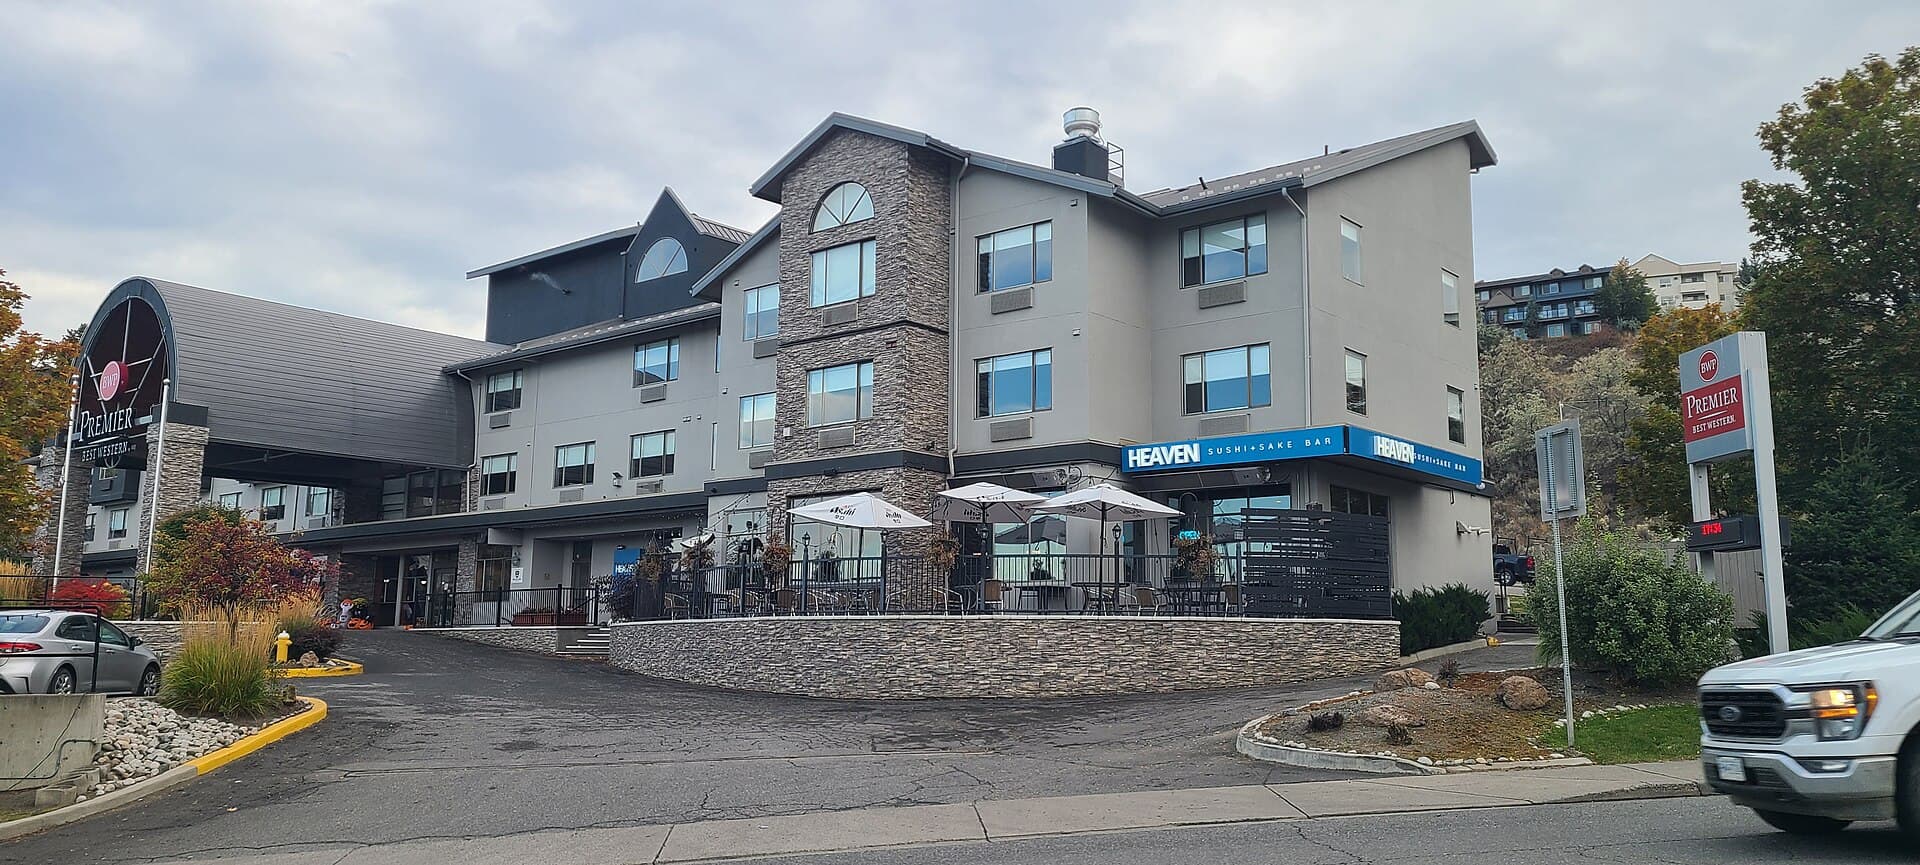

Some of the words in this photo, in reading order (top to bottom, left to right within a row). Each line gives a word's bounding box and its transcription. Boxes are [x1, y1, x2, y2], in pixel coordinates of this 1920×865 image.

[1700, 359, 1717, 374] BWP
[103, 373, 118, 389] BWP
[1686, 387, 1738, 419] PREMIER
[79, 407, 133, 442] PREMIER
[1692, 423, 1707, 434] BEST
[81, 448, 97, 462] BEST
[97, 441, 128, 459] WESTERN
[1128, 443, 1200, 468] HEAVEN
[1305, 437, 1332, 447] BAR
[1374, 435, 1414, 464] HEAVEN
